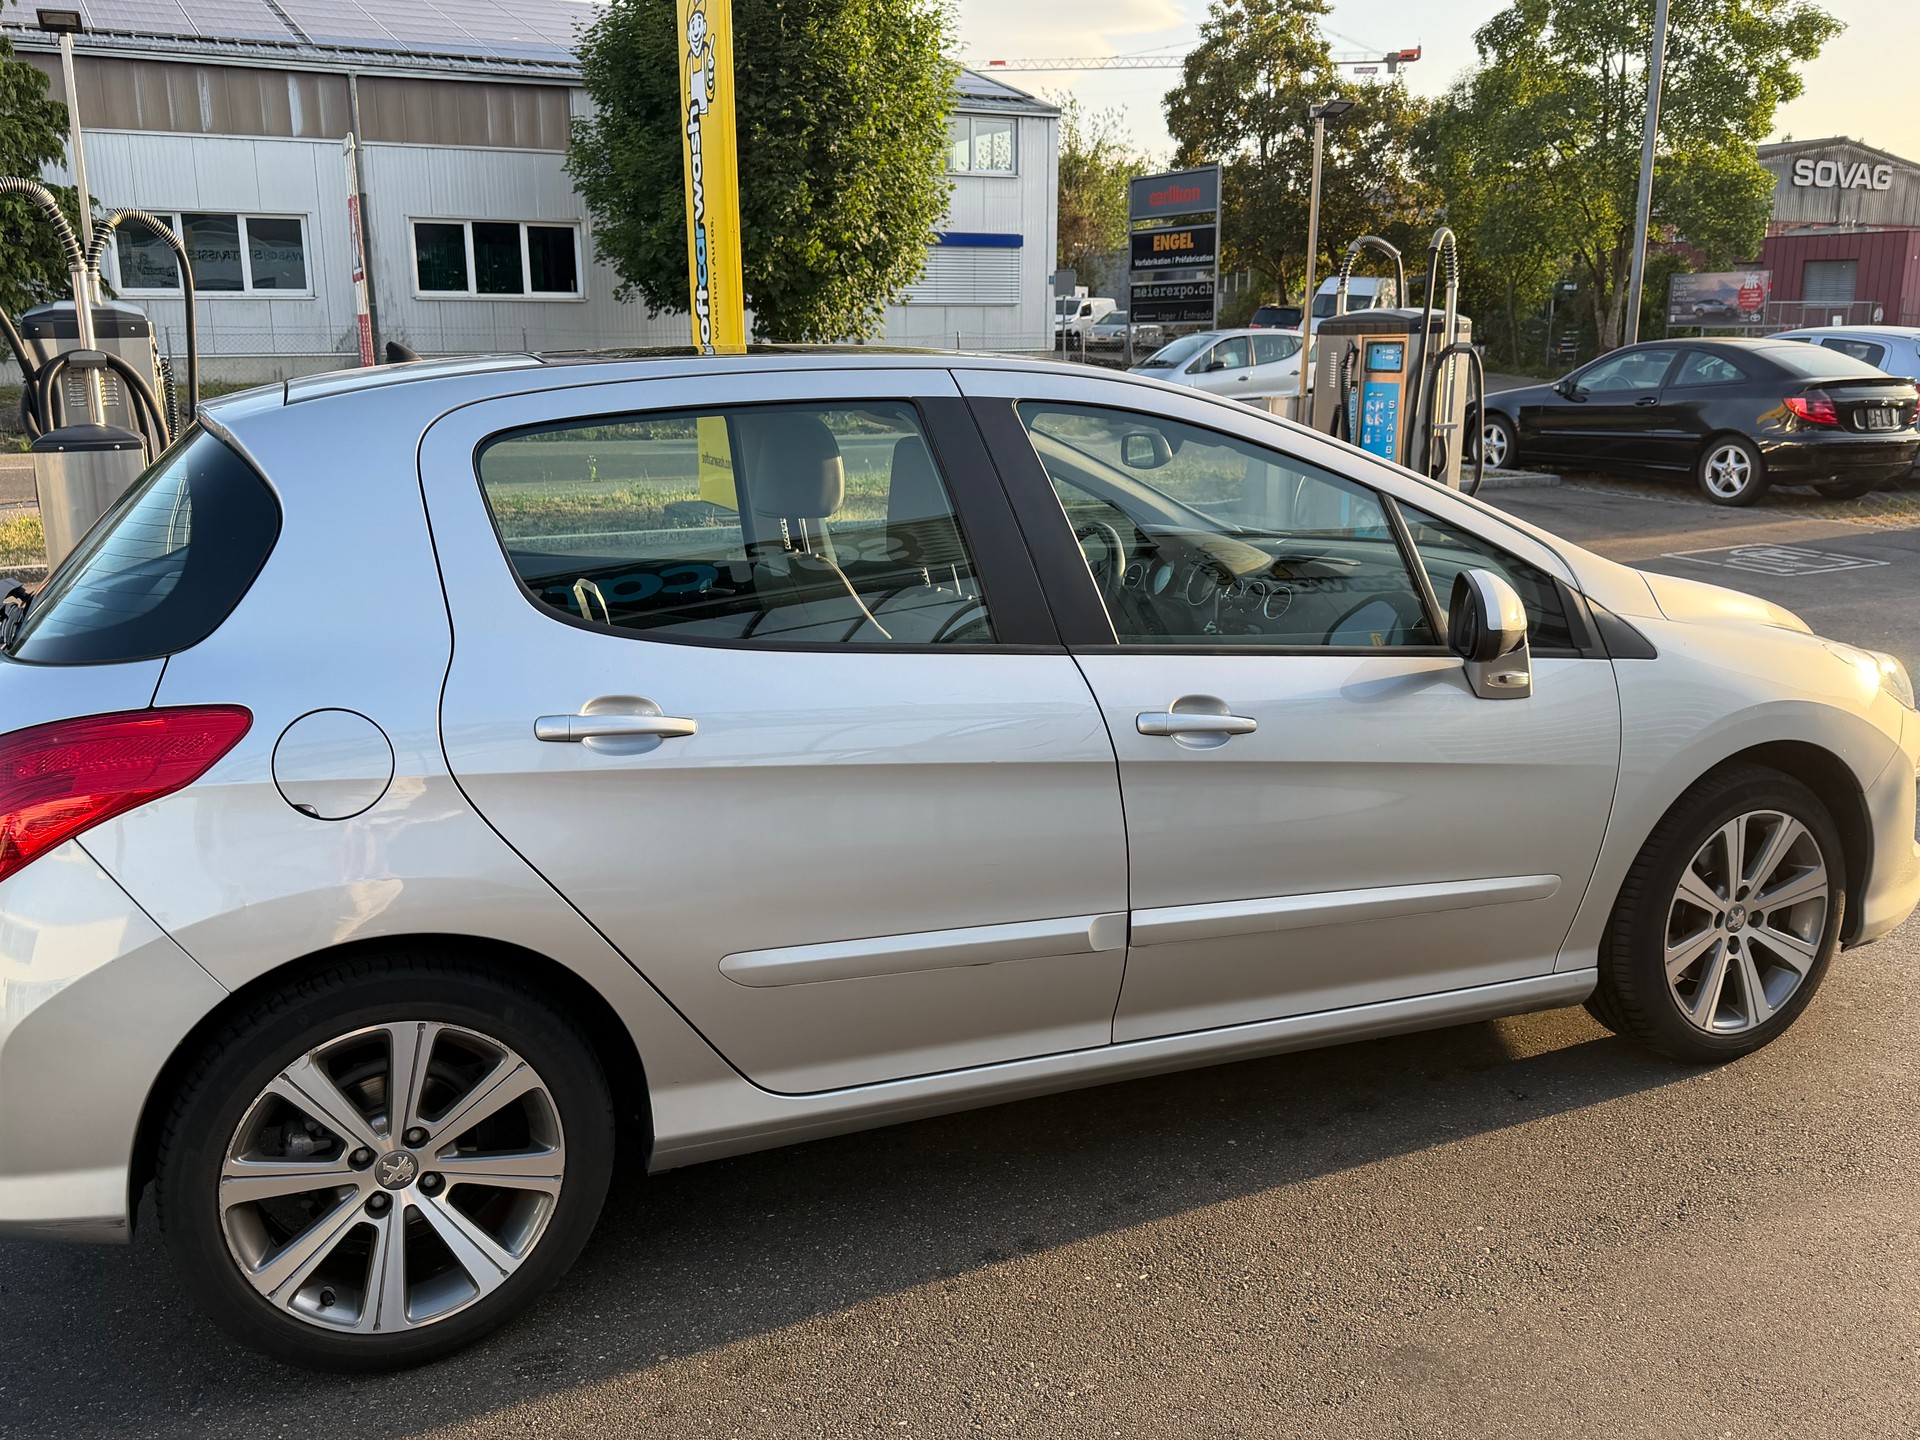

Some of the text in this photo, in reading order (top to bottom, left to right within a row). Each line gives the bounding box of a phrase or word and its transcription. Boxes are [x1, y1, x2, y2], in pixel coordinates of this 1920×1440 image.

[1793, 159, 1893, 190] SOVAG
[1153, 232, 1194, 252] ENGEL
[1133, 282, 1213, 299] meierexpo.ch
[1386, 400, 1395, 461] STAUB
